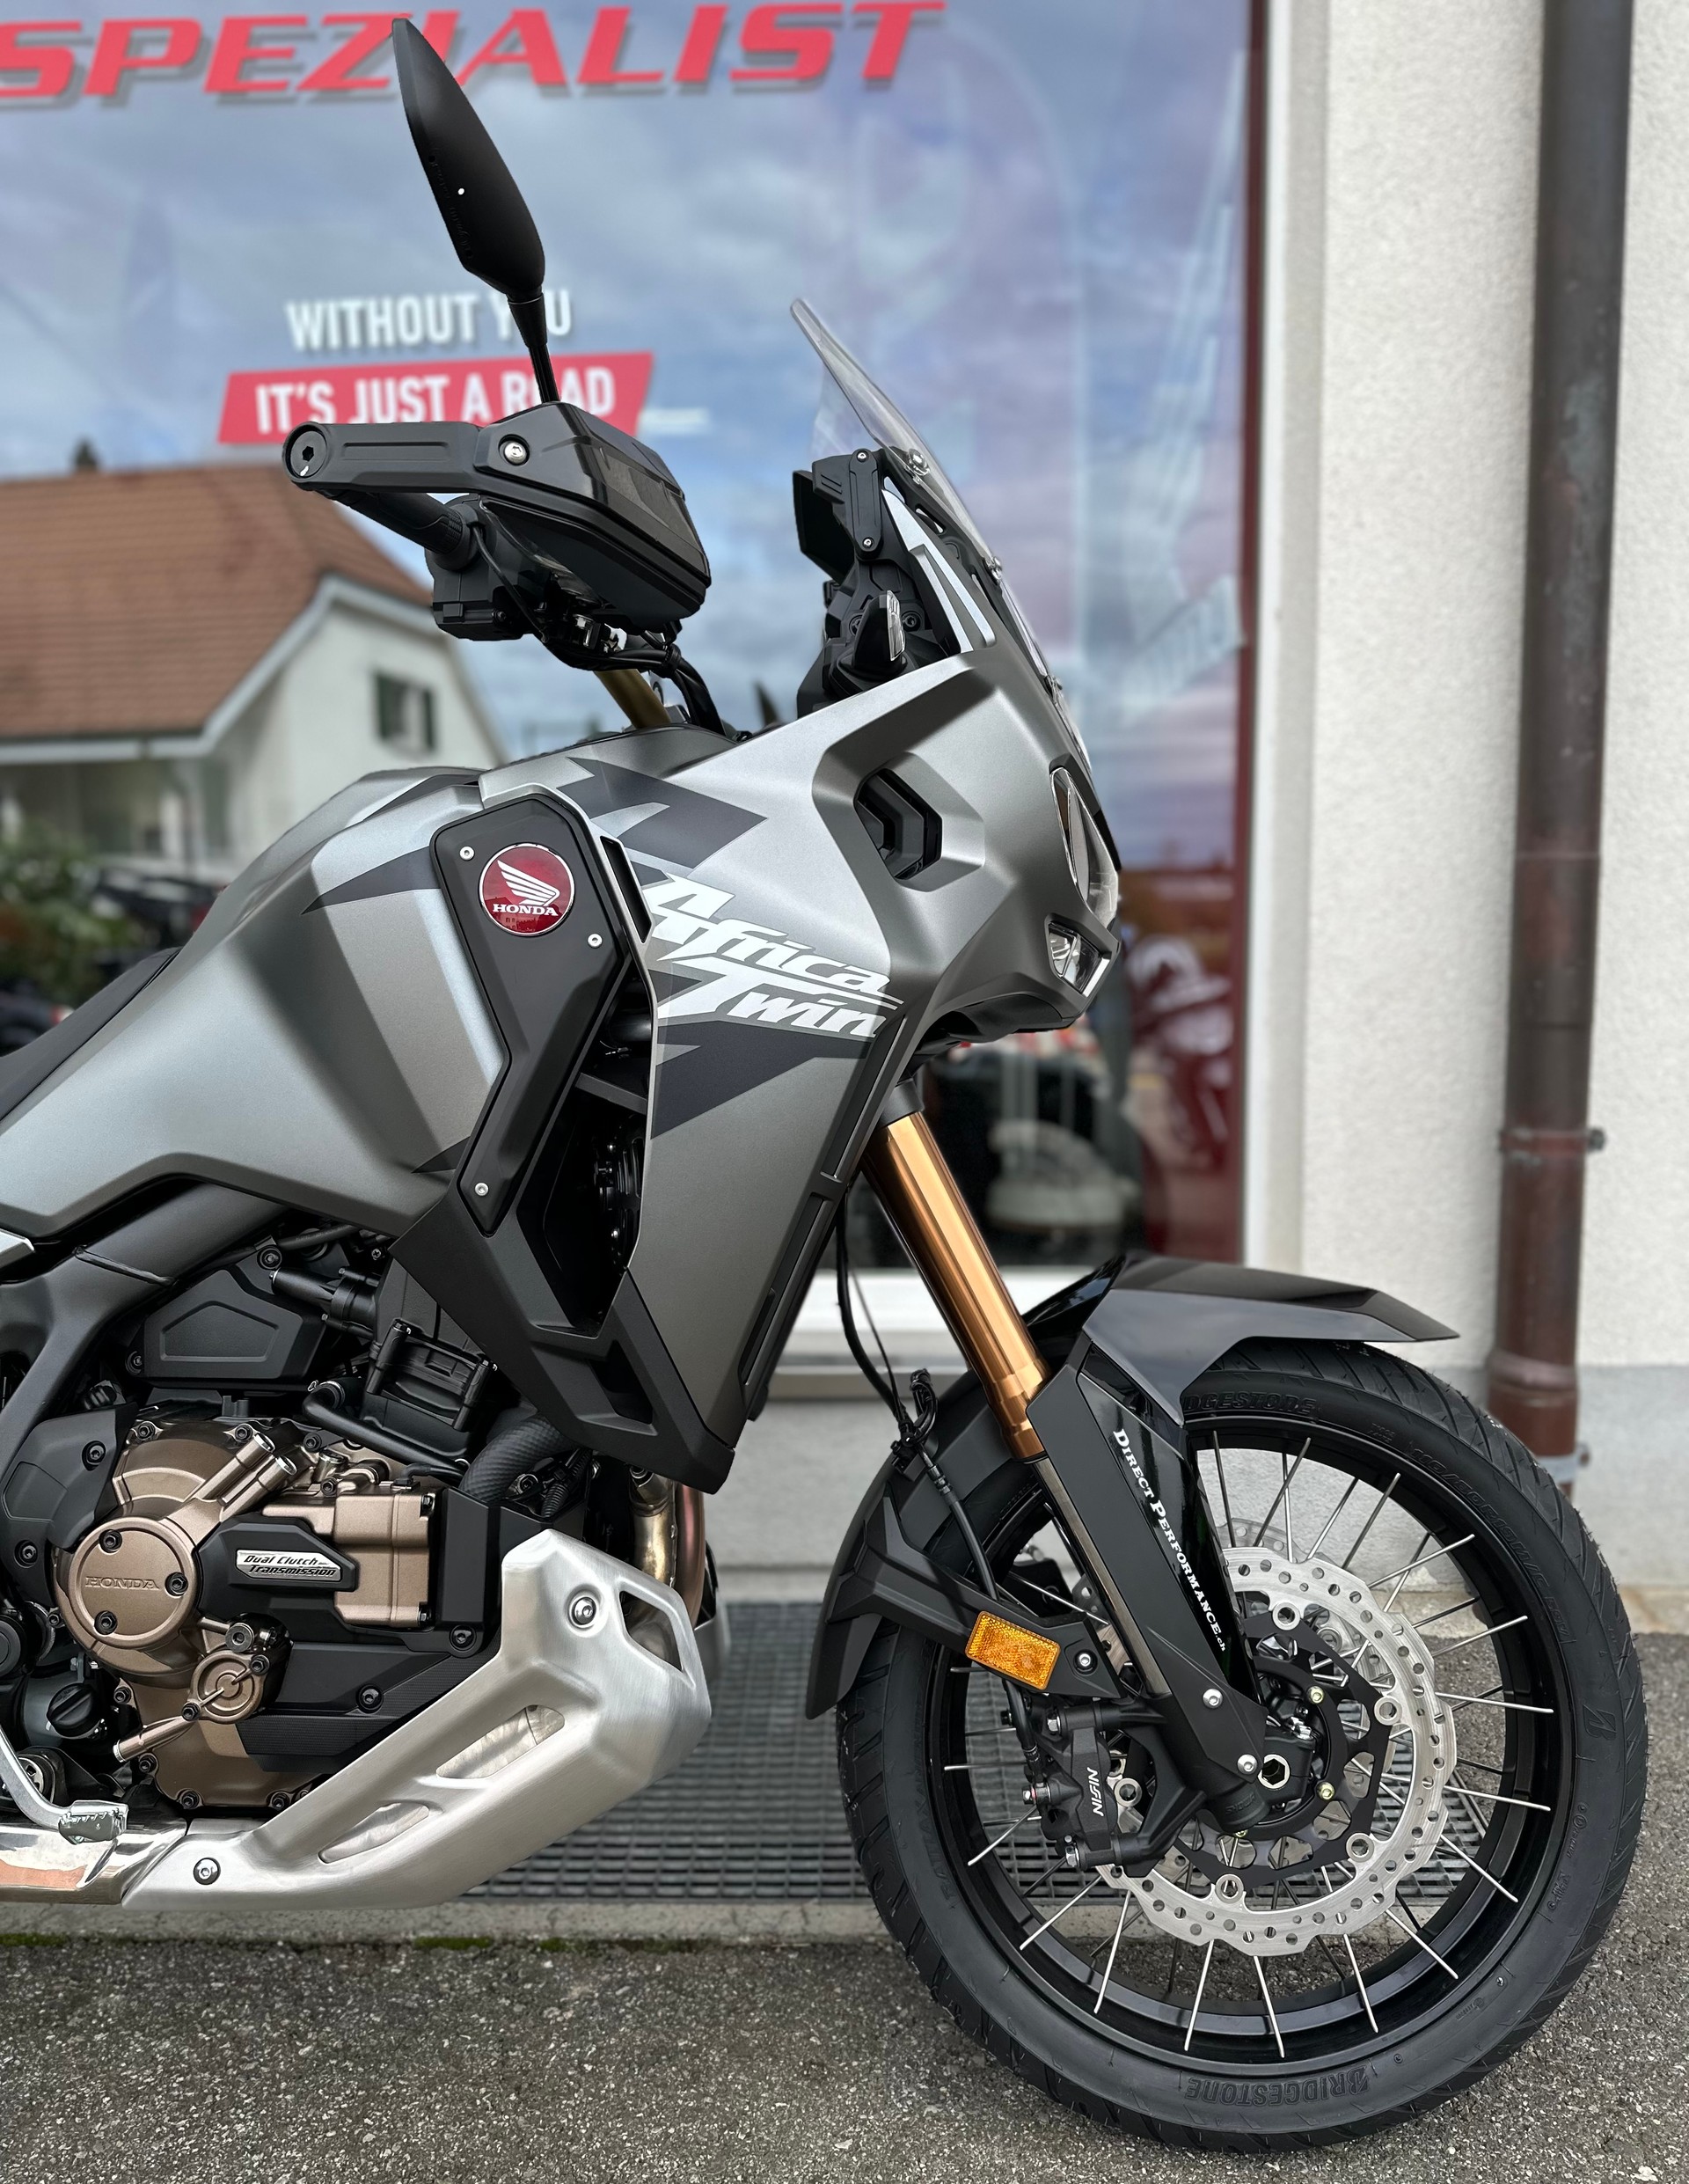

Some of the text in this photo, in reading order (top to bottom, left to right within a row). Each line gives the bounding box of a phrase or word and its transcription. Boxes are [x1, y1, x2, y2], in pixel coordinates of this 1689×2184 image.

[285, 289, 573, 350] WITHOUT YU
[256, 366, 614, 434] IT'S JUST A RAD
[493, 903, 559, 916] HONDA
[643, 871, 892, 996] Africa
[657, 955, 903, 1038] Twin
[1183, 1389, 1318, 1416] DGESTONE
[1113, 1428, 1155, 1498] DIRECT
[85, 1575, 160, 1591] HONDA
[244, 1555, 318, 1566] Dual Clutch
[248, 1565, 337, 1577] Transmission
[1086, 1766, 1105, 1817] NISSIN
[1185, 2066, 1370, 2107] BRIDGESTONE
